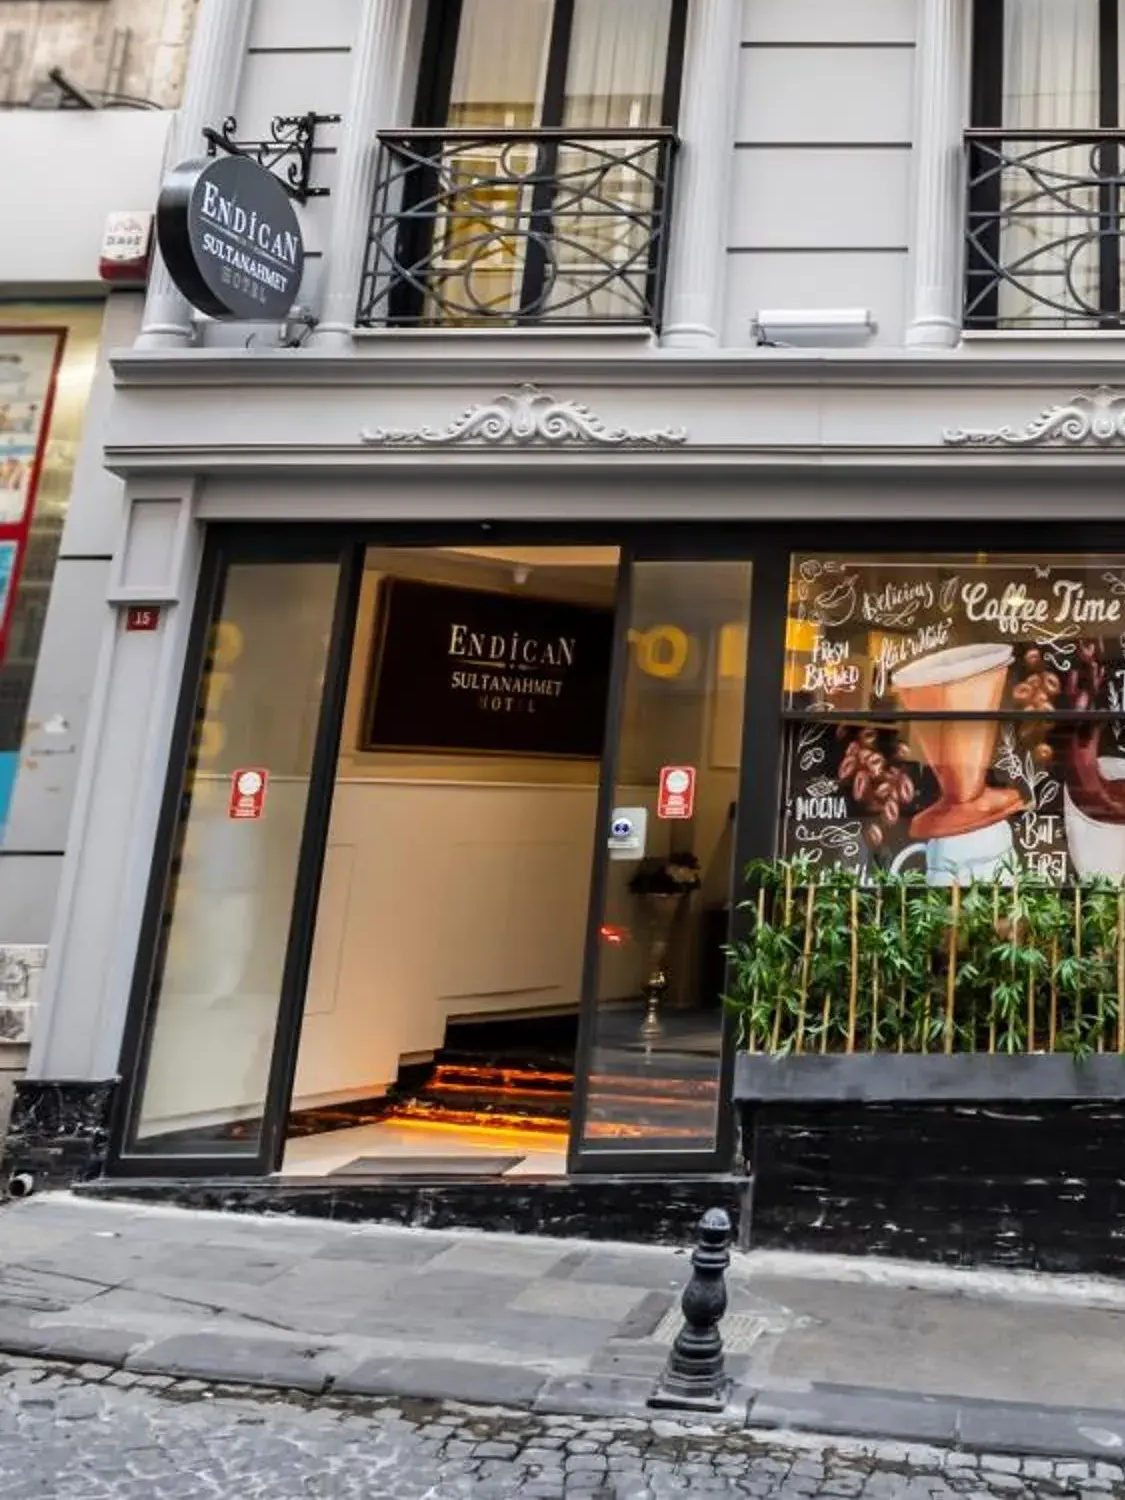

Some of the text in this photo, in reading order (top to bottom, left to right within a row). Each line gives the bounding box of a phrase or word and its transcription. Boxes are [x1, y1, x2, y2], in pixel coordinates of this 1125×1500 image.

[202, 233, 288, 293] SULTANAHMET
[961, 579, 1122, 634] Coffee Time
[451, 671, 563, 697] SULTANAHMET
[478, 694, 536, 714] HOTL
[795, 797, 847, 821] MOCHA
